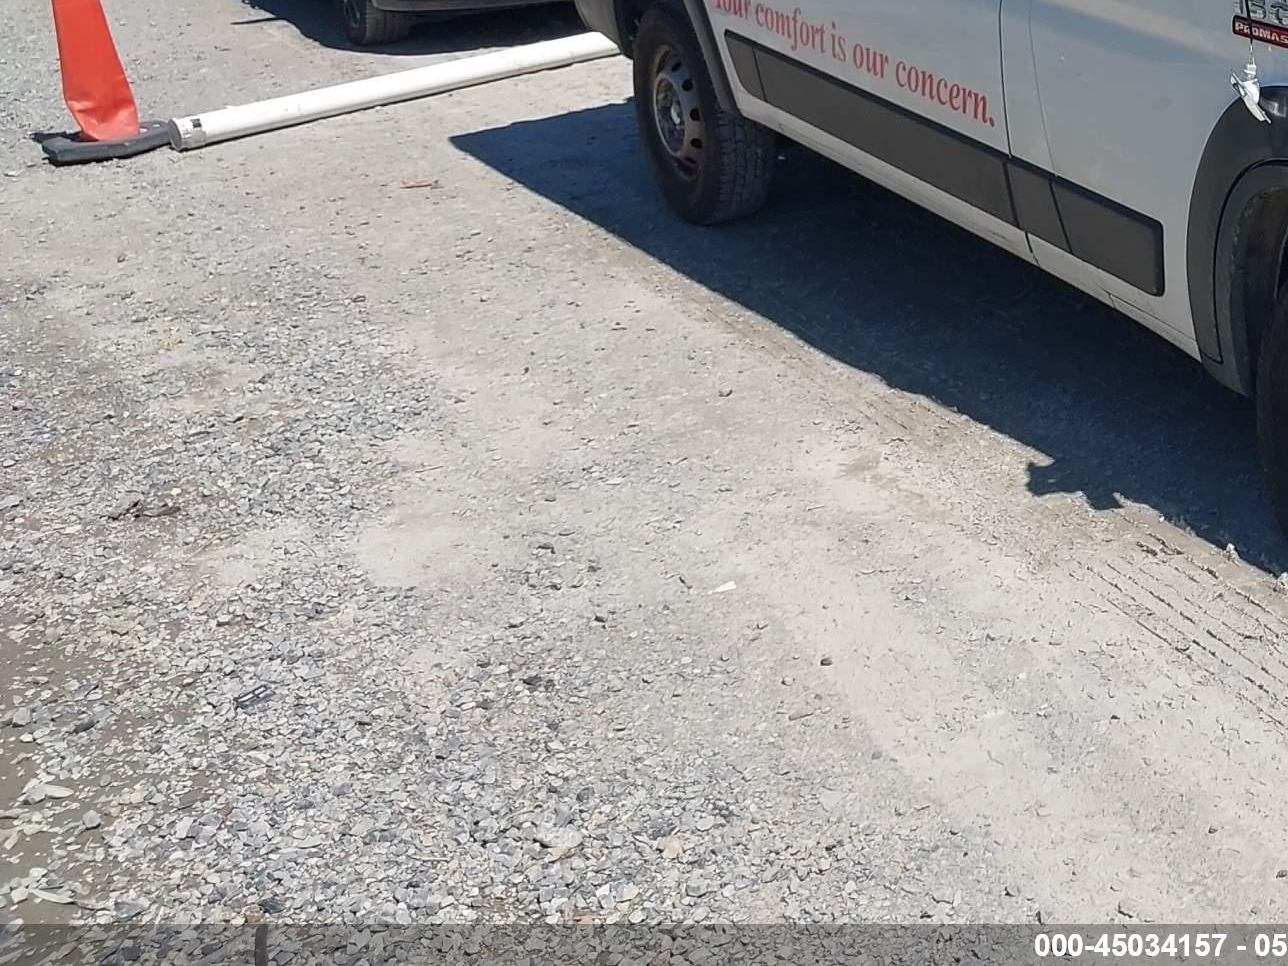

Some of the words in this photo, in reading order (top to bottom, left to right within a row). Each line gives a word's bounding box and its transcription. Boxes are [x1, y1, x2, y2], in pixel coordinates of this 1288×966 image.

[755, 7, 826, 51] comfort
[832, 22, 847, 63] is
[853, 42, 889, 79] our
[896, 60, 995, 127] concern.
